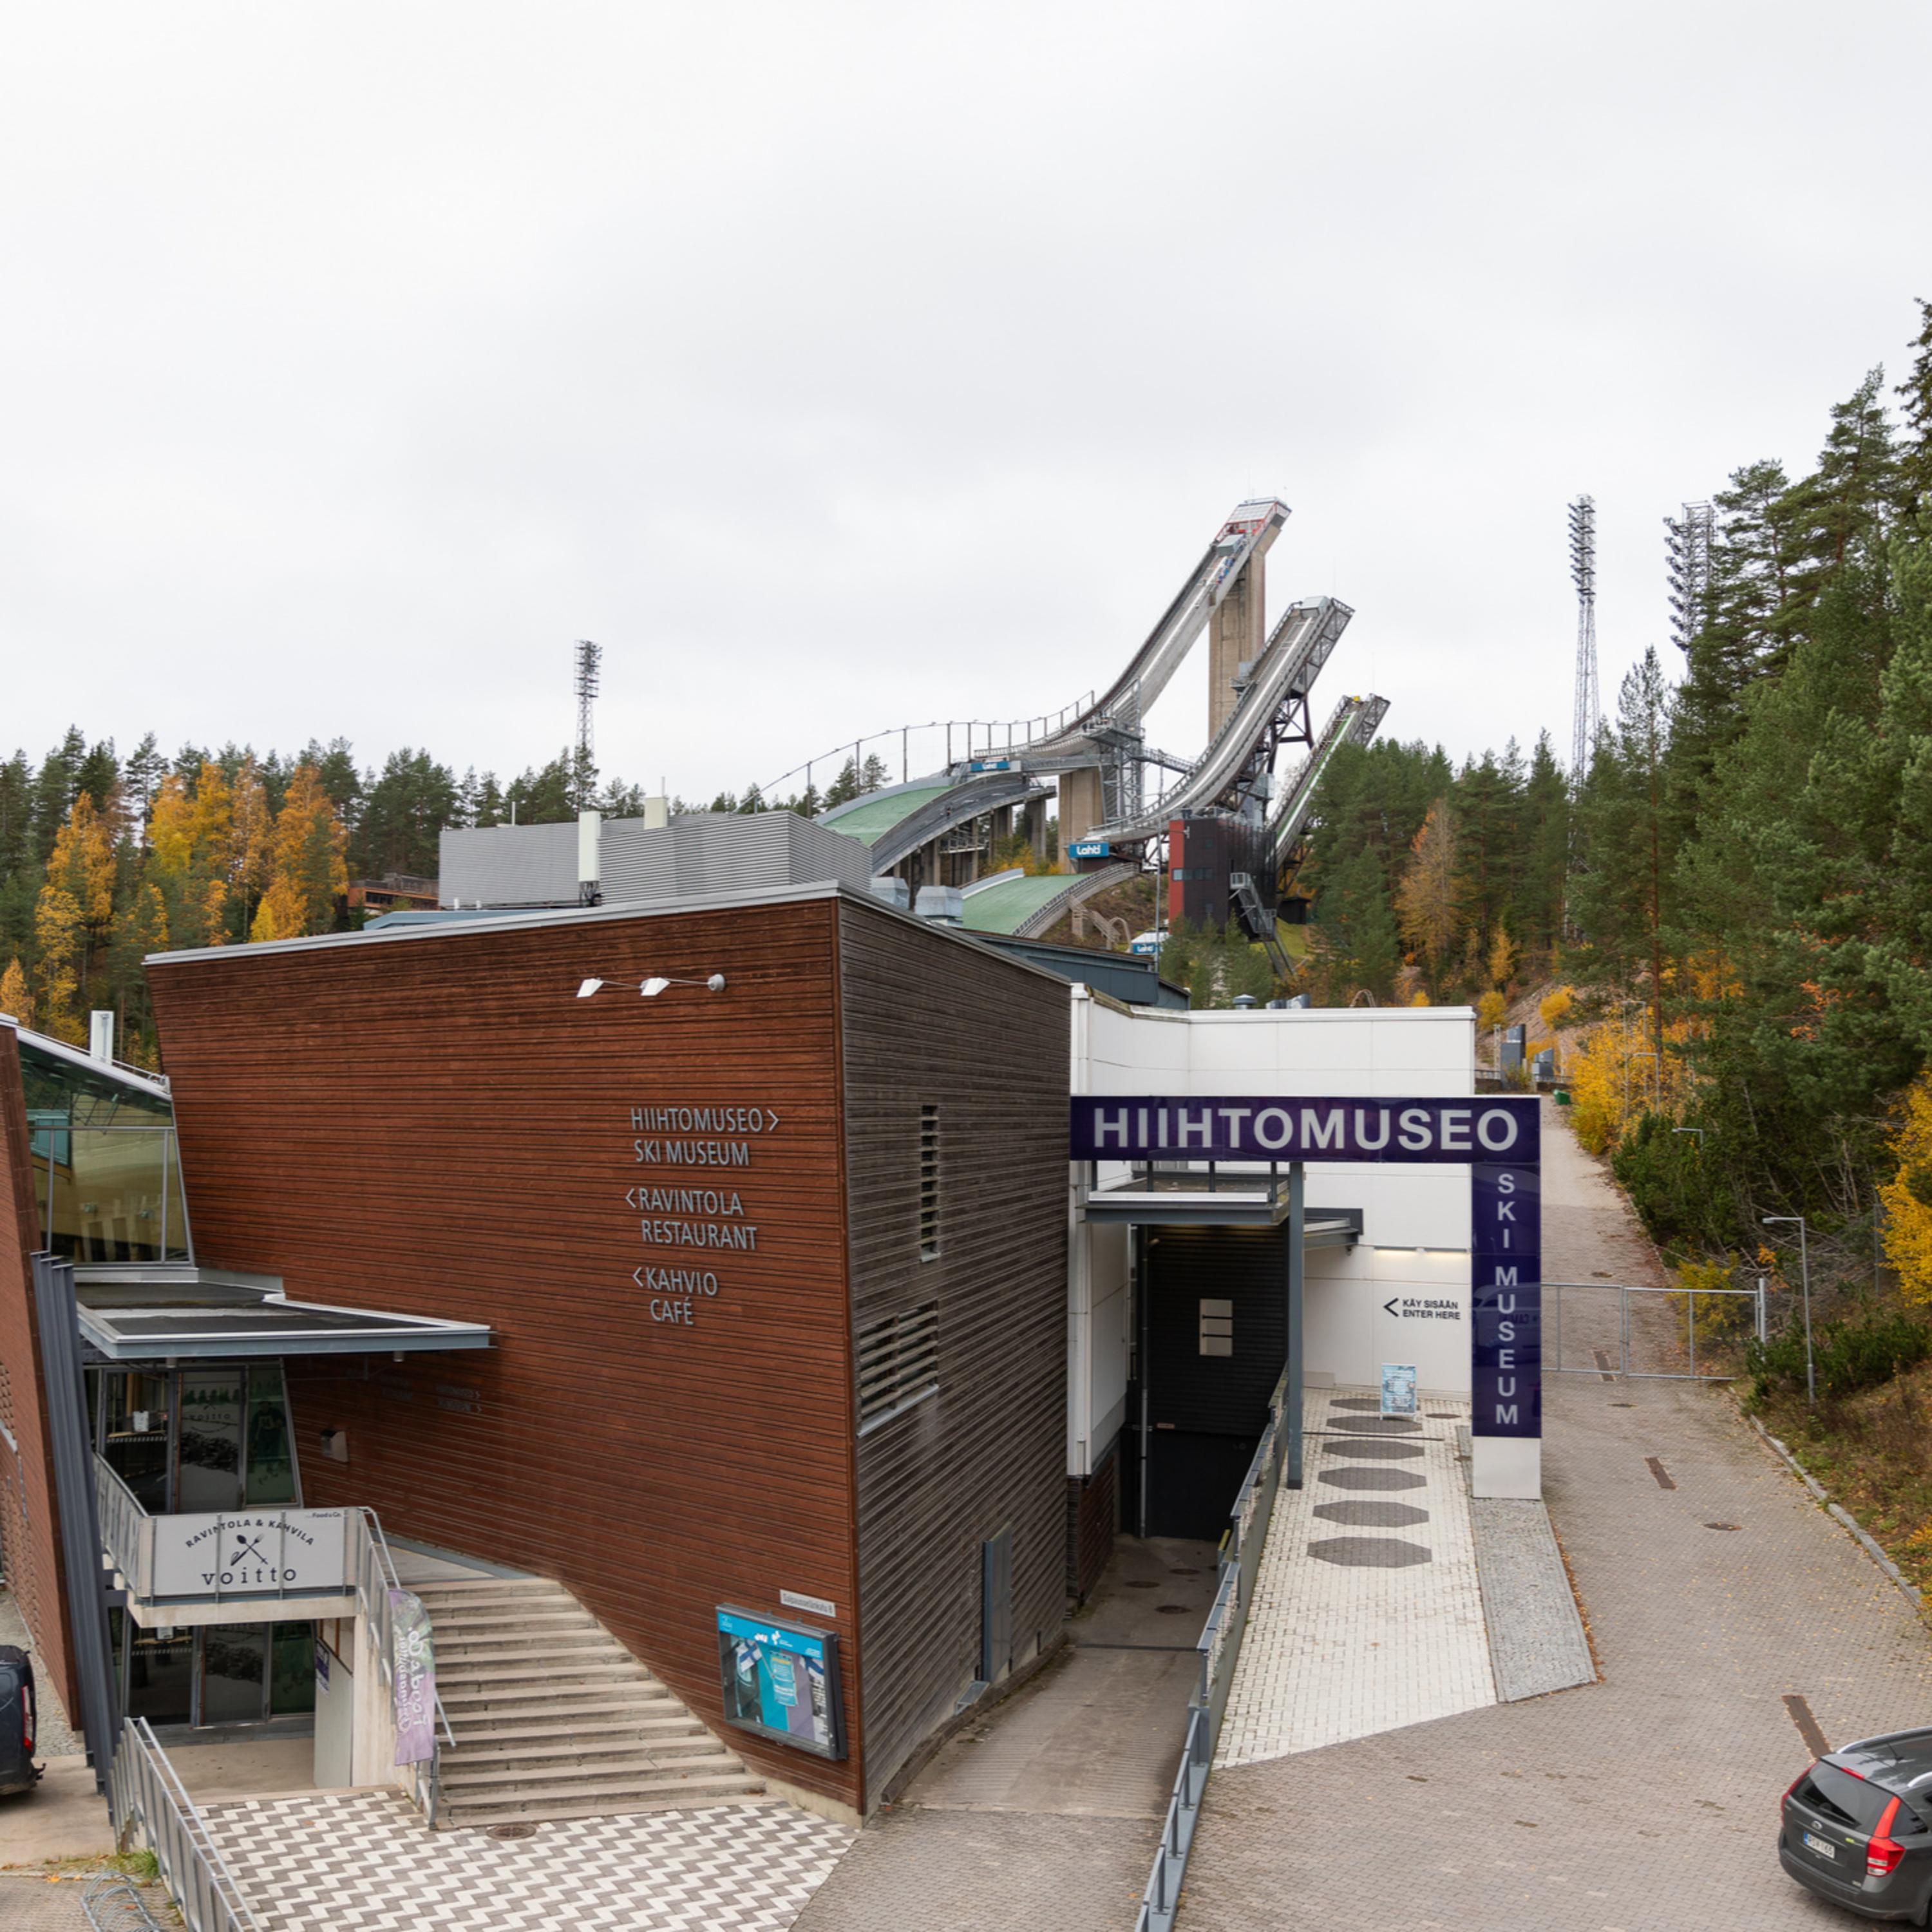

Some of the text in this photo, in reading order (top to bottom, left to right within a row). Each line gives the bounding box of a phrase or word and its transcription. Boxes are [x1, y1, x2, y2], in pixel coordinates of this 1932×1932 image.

[1076, 844, 1101, 855] Lahti
[630, 1108, 764, 1132] HIIHTOMUSEO
[1094, 1107, 1518, 1151] HIIHTOMUSEO
[634, 1139, 750, 1166] SKI MUSEUM
[638, 1188, 744, 1216] RAVINTOLA
[1497, 1173, 1516, 1248] SKI
[641, 1220, 757, 1250] RESTAURANT
[645, 1267, 718, 1296] KAHVIO
[650, 1296, 694, 1325] CAFÉ
[1403, 1298, 1458, 1309] KÄY SISÄÄN
[1403, 1309, 1461, 1320] ENTER HERE
[1495, 1266, 1518, 1425] MUSEUM
[185, 1519, 314, 1548] RAVINTOLA & KAHVILA
[202, 1566, 296, 1586] voitto
